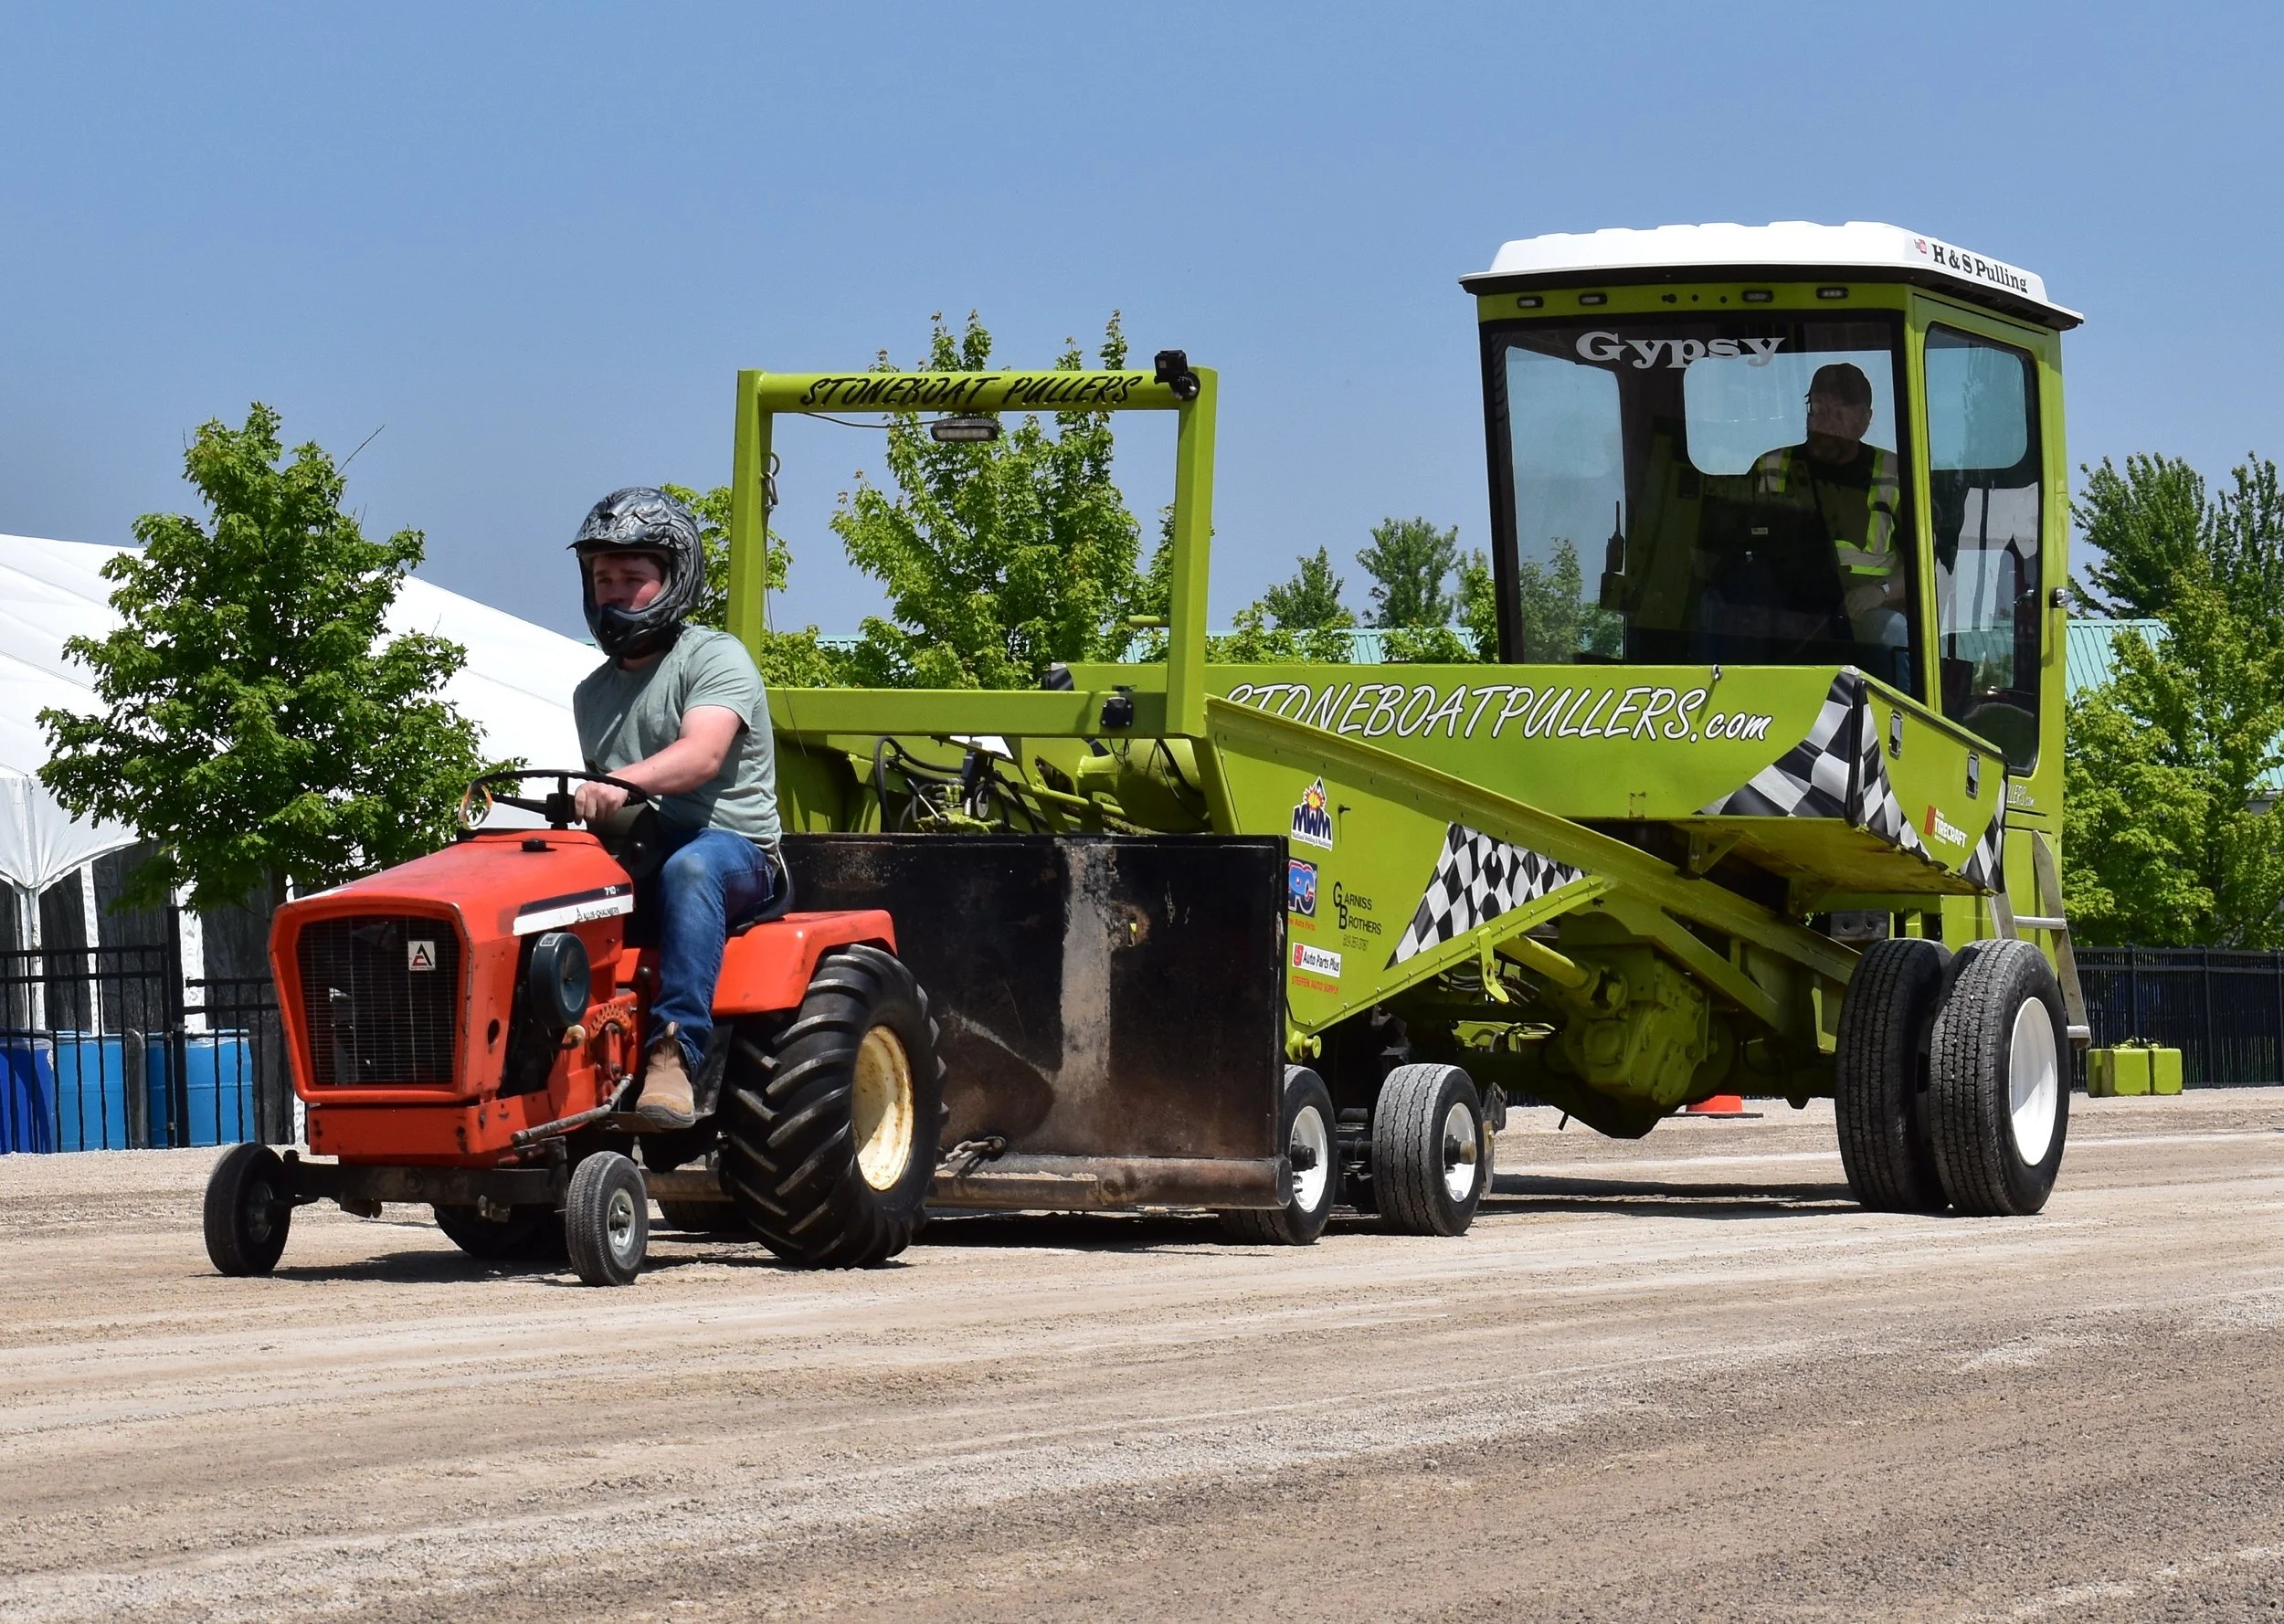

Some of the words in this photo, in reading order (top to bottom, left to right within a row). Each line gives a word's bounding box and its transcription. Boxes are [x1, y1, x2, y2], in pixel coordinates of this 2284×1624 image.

[1931, 243, 1946, 266] H
[1949, 249, 1961, 270] &
[1961, 253, 1972, 274] S
[1974, 258, 2028, 294] Pulling
[1575, 331, 1787, 369] Gypsy
[799, 375, 1002, 406] STONEBOAT
[1001, 374, 1144, 406] PULLERS
[1292, 804, 1332, 841] MWM
[1333, 881, 1373, 911] GARNISS
[1338, 903, 1382, 935] BROTHERS
[1303, 951, 1316, 965] Auto
[1316, 954, 1329, 969] Parts
[1329, 957, 1340, 972] Plus
